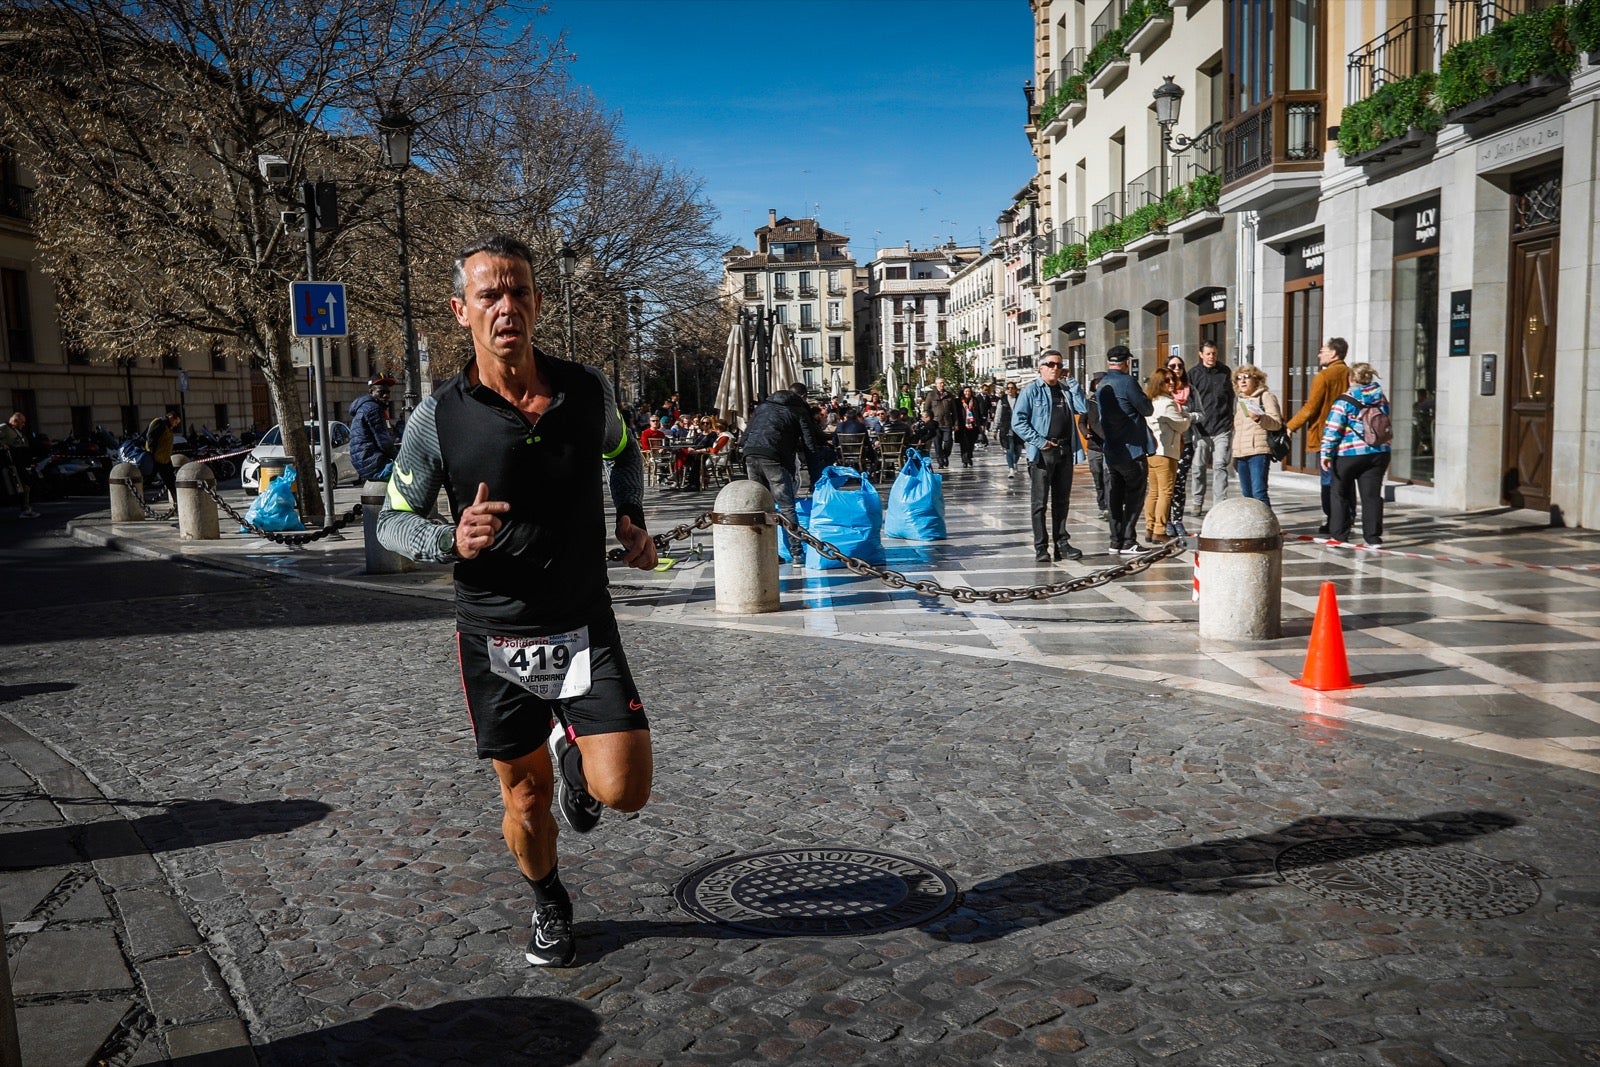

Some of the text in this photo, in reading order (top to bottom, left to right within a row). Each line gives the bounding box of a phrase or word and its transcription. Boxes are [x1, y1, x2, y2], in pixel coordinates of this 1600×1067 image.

[1416, 208, 1436, 229] LCV
[505, 639, 548, 648] Solidaria
[508, 645, 569, 671] 419
[727, 859, 768, 874] DE
[769, 852, 906, 871] NACIONAL
